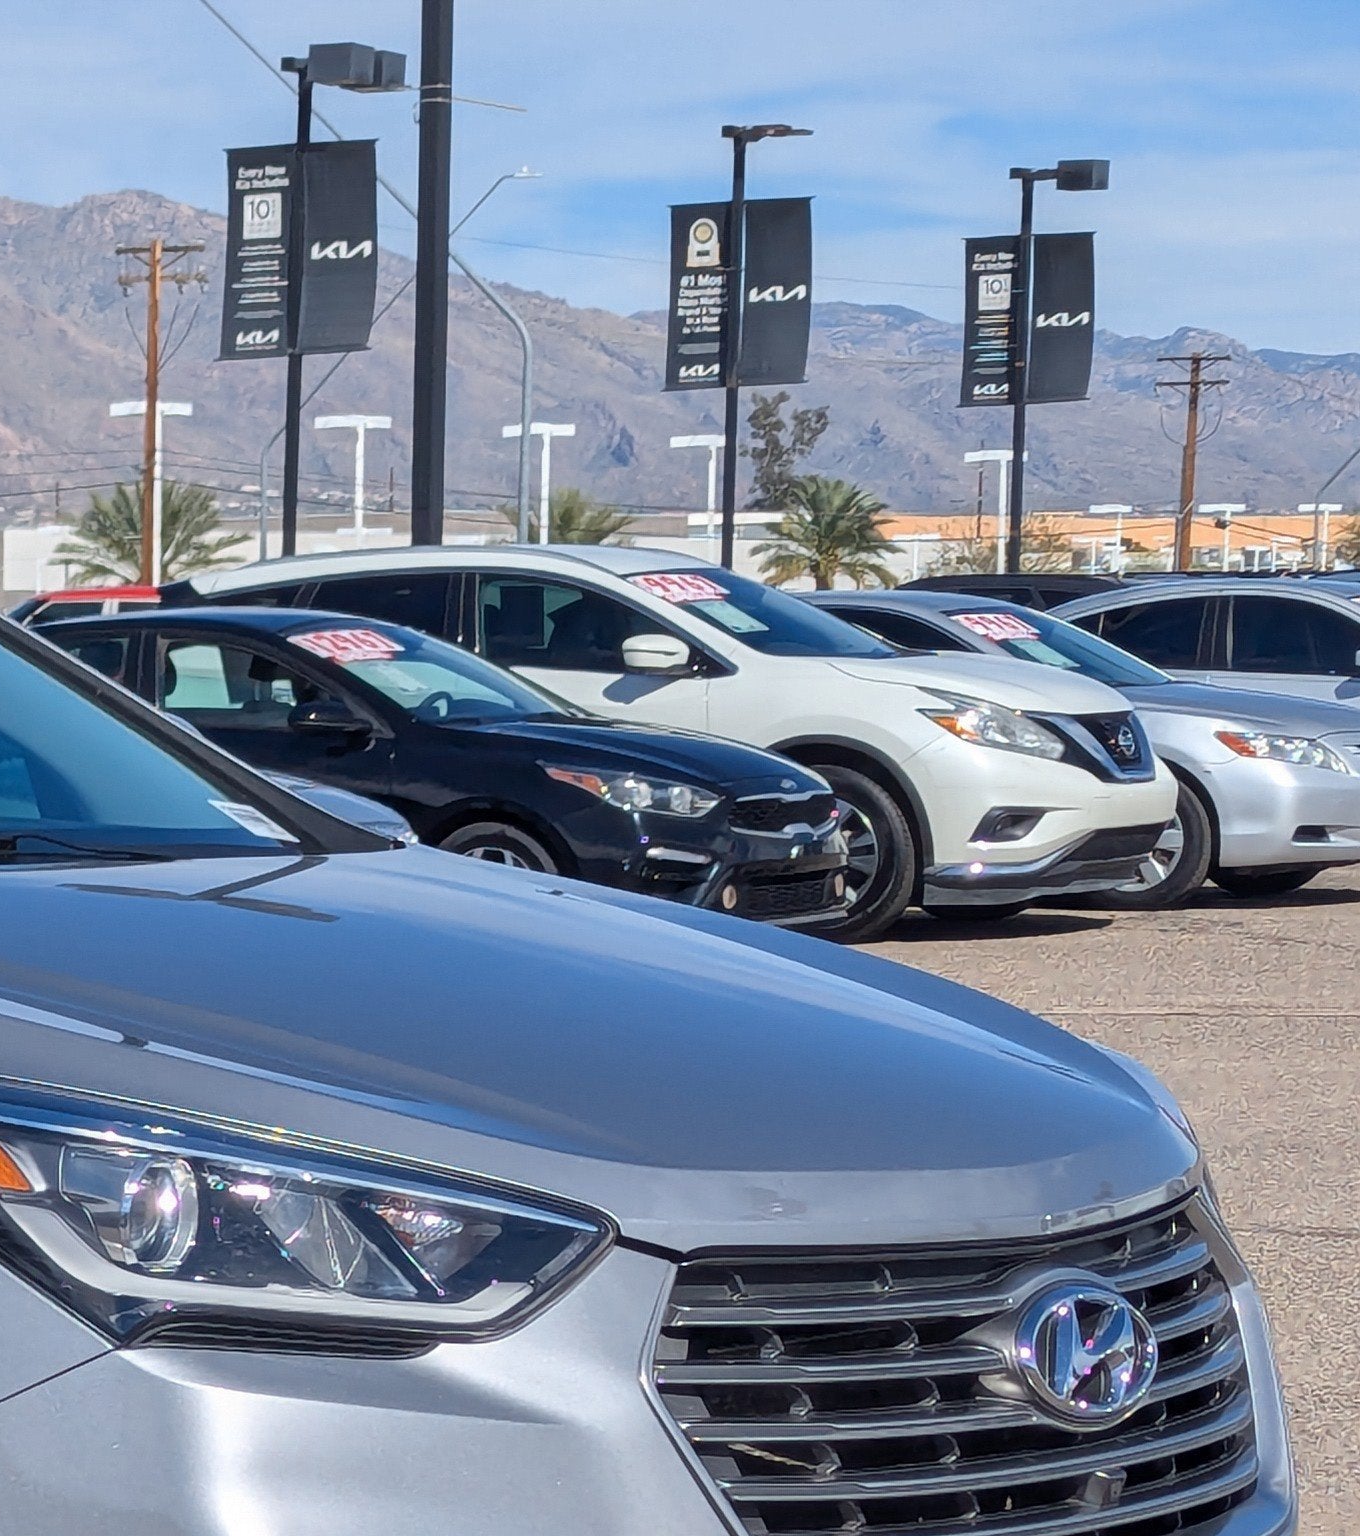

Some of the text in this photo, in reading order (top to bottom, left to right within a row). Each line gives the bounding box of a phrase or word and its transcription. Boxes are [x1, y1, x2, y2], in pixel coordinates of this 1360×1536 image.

[248, 199, 270, 221] 10
[310, 240, 373, 260] KIA
[748, 284, 807, 303] KIA
[983, 279, 1003, 295] 10
[1036, 311, 1091, 328] KIA
[235, 328, 280, 346] KIA
[679, 363, 720, 378] KIA
[973, 382, 1010, 396] KIA
